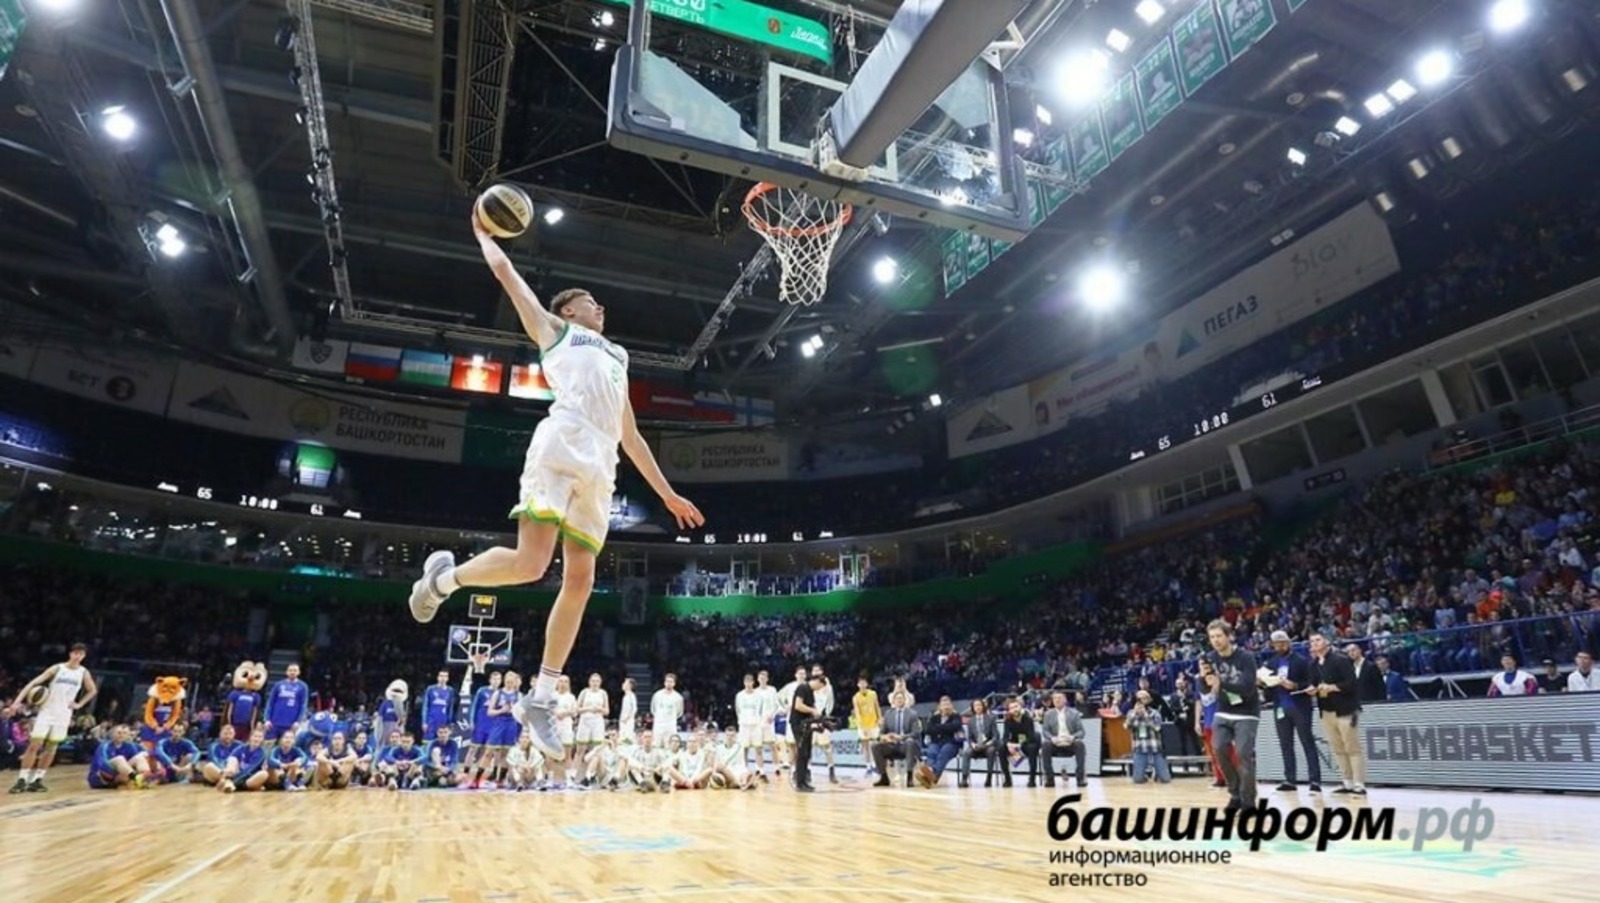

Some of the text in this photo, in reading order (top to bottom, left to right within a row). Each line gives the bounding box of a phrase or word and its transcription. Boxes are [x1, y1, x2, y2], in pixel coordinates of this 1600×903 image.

[1203, 294, 1258, 336] ПЕГАЗ
[338, 406, 428, 431] РЕСПУБЛИКА
[336, 423, 446, 450] БАШКОРТОСТАН
[1158, 435, 1171, 450] 65
[701, 443, 765, 456] РЕСПУБЛИКА
[701, 455, 780, 469] БАШКОРТОСТАН
[196, 486, 213, 500] 65
[1366, 724, 1598, 762] COMBASKET
